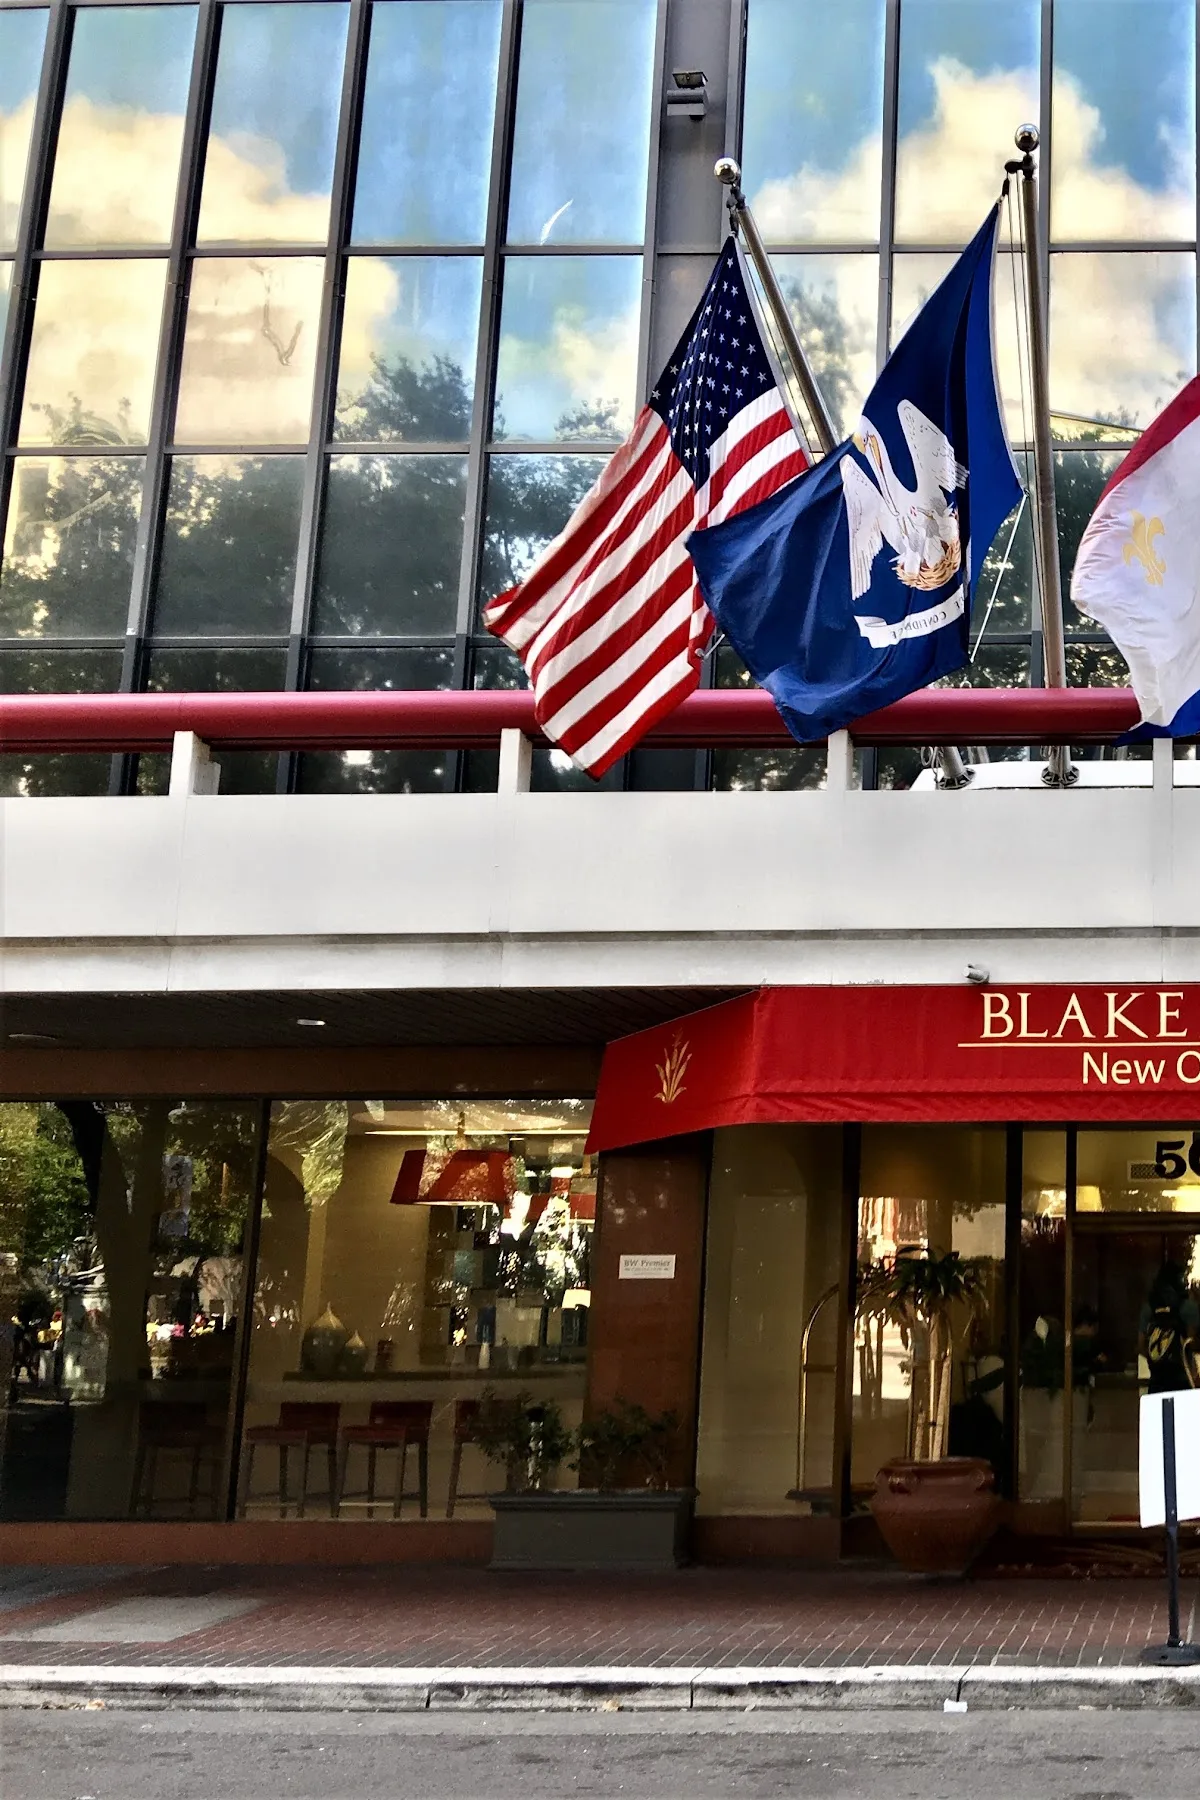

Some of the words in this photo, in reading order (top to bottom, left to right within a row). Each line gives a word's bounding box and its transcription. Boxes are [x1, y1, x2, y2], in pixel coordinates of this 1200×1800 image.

[981, 992, 1187, 1038] BLAKE
[1083, 1052, 1165, 1084] New
[641, 1259, 671, 1267] Premier
